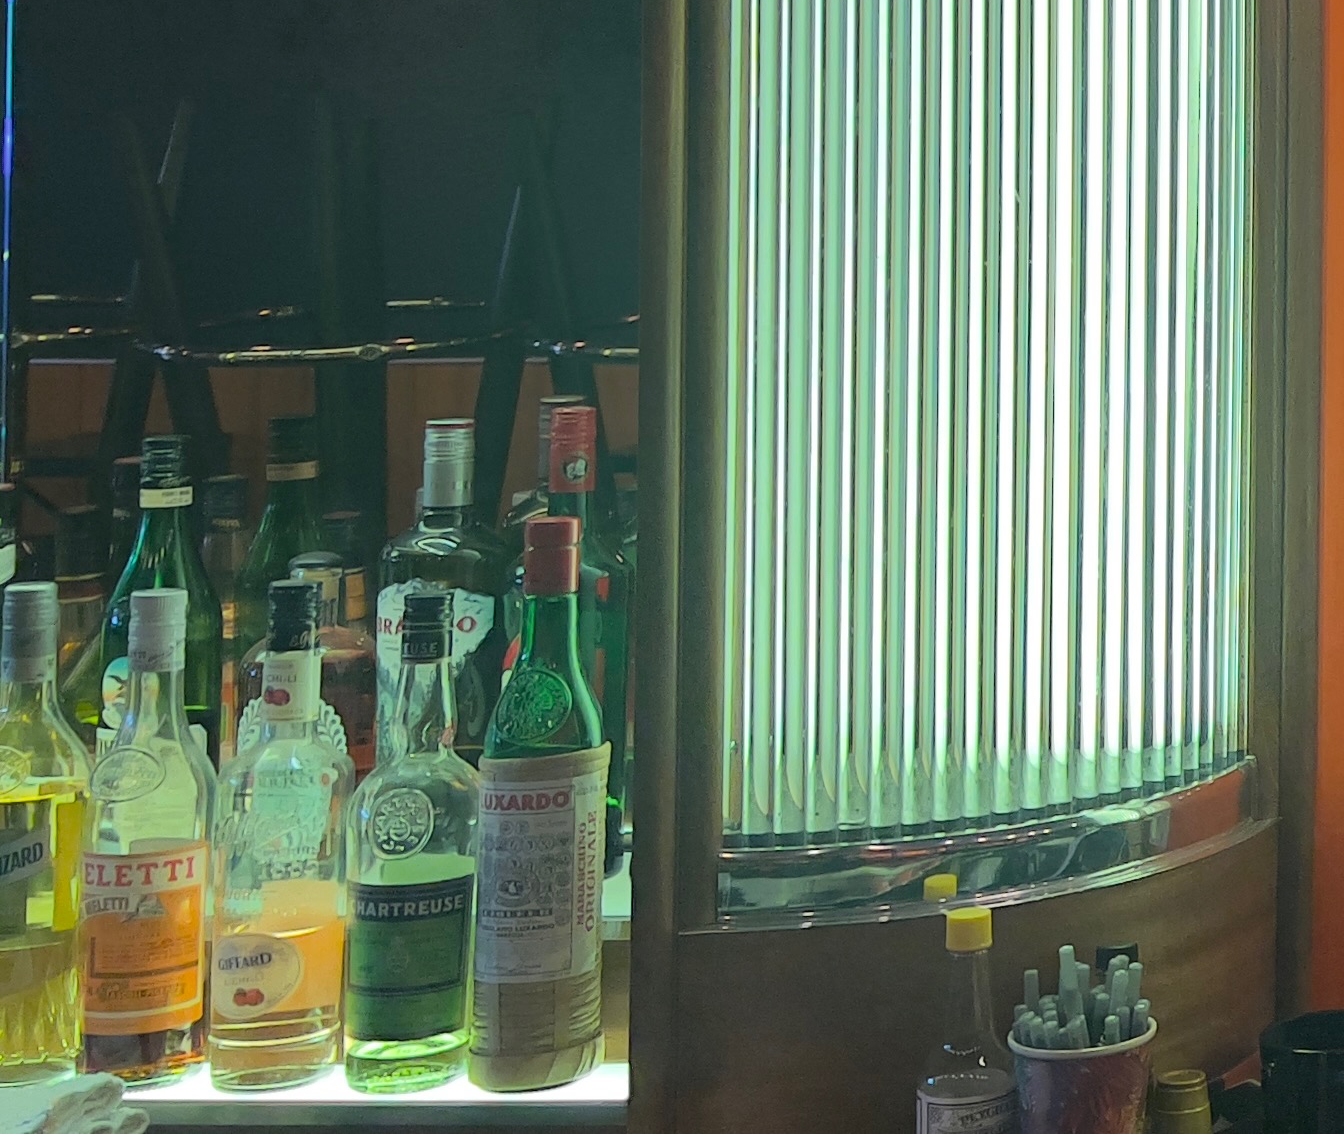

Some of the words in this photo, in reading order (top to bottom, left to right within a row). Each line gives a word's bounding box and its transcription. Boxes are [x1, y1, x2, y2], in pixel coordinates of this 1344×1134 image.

[484, 791, 570, 812] UXARDO
[0, 841, 44, 876] ZARD
[84, 855, 195, 888] ELETTI
[218, 951, 273, 971] GIFFARD
